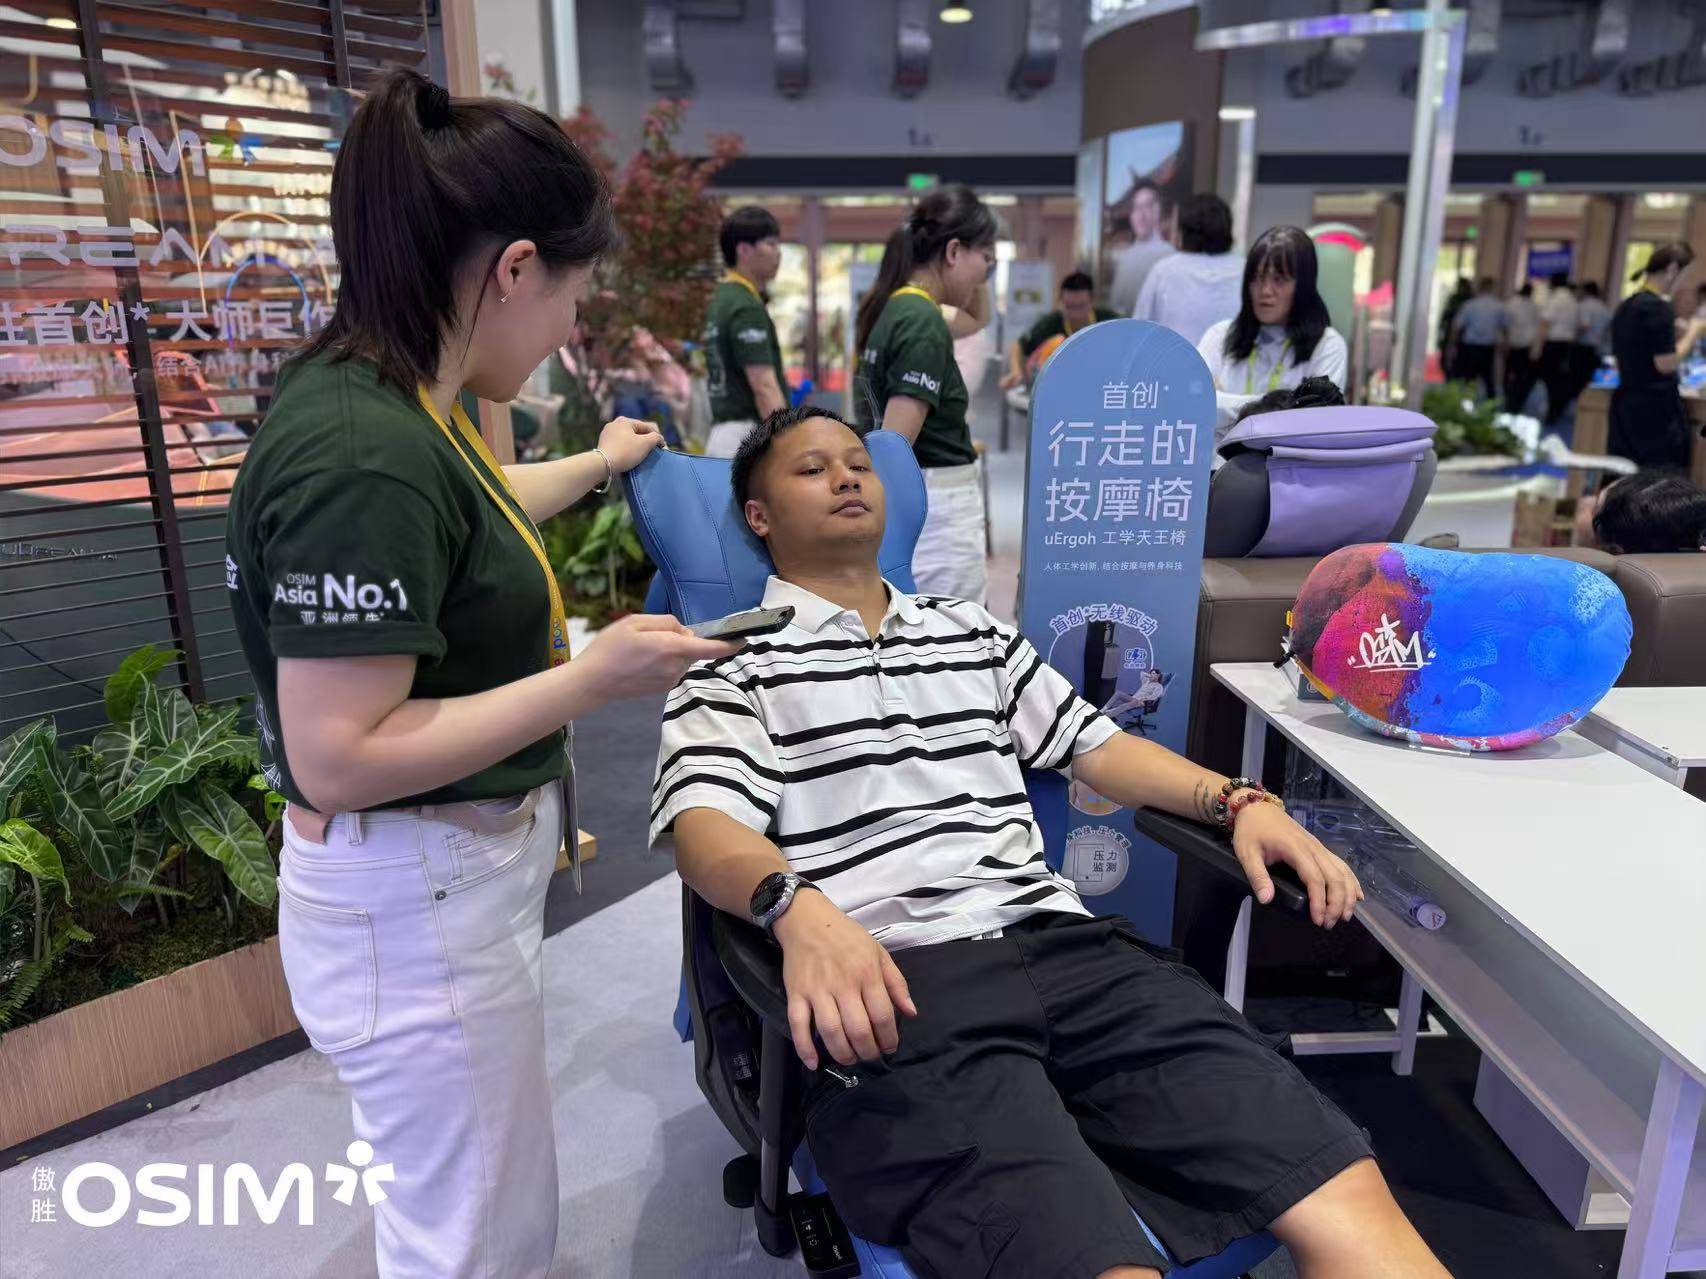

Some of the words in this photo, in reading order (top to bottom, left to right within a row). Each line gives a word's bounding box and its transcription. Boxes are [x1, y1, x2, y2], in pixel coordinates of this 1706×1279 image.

[0, 114, 206, 176] OSIM
[1047, 419, 1198, 467] 行走的
[1045, 476, 1193, 522] 按摩椅
[1044, 531, 1096, 549] uErgoh
[1102, 529, 1187, 546] 工学天王椅
[274, 583, 318, 606] Asia
[323, 572, 408, 612] No.1
[287, 572, 316, 586] OSIM
